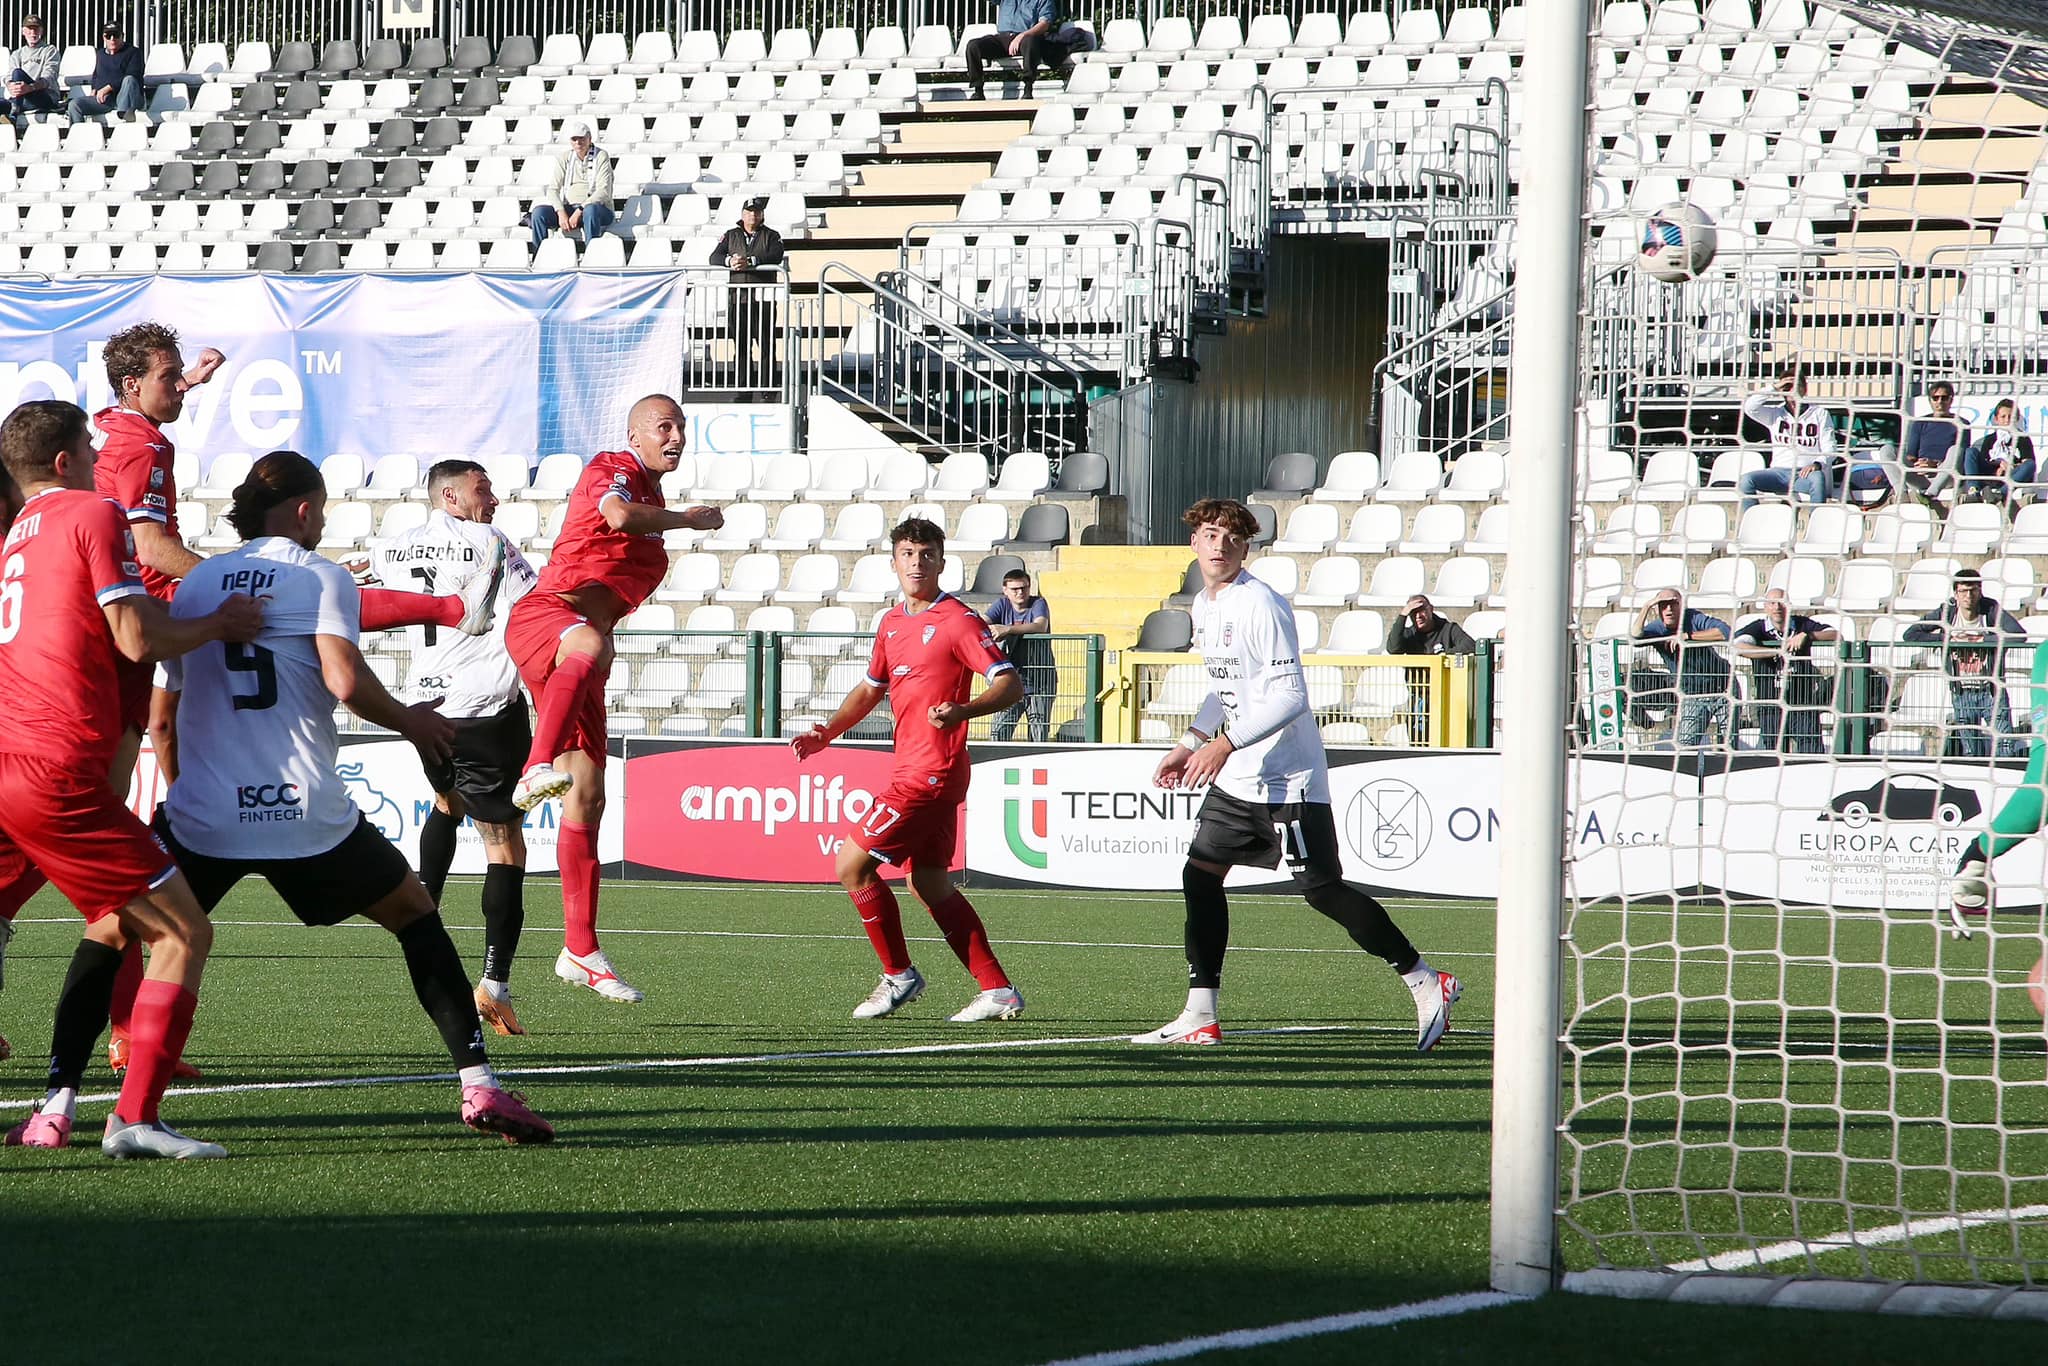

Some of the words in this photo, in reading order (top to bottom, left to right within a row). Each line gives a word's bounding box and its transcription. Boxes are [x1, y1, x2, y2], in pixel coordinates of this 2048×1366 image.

[685, 414, 782, 455] ICE
[221, 568, 276, 597] nepi
[0, 553, 26, 644] 6
[237, 783, 302, 809] ISCC
[680, 775, 875, 836] amplifo
[1061, 792, 1202, 821] TECNIT
[239, 809, 304, 823] FINTECH
[866, 803, 901, 835] 17
[1061, 834, 1168, 855] Valutazioni
[1800, 833, 1899, 853] EUROPA
[1909, 836, 1960, 854] CAR
[1856, 865, 1882, 874] USAT
[1884, 856, 1894, 864] DI
[1897, 856, 1929, 865] TUTTE
